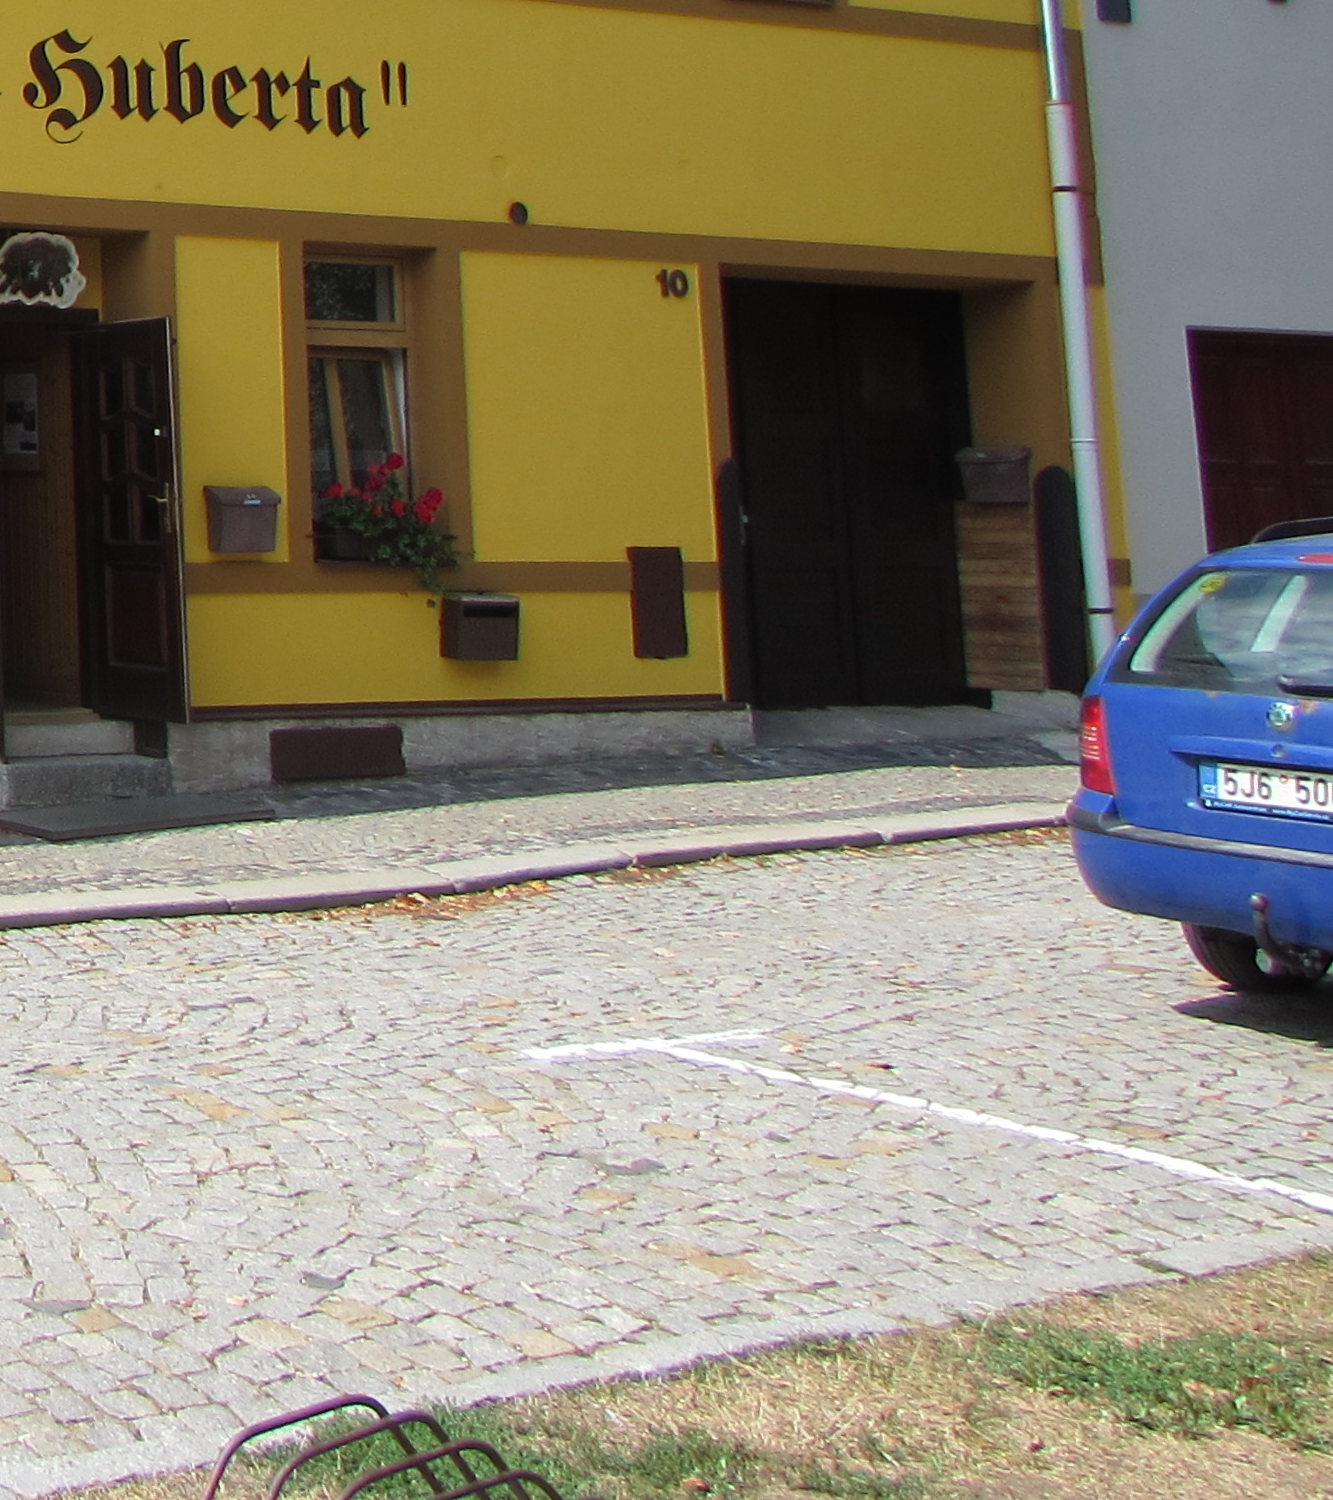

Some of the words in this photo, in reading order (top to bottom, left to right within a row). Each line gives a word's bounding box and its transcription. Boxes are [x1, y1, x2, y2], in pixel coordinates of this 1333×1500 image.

[655, 269, 688, 298] 10
[1223, 767, 1272, 800] 5J6
[1295, 775, 1333, 808] 50
